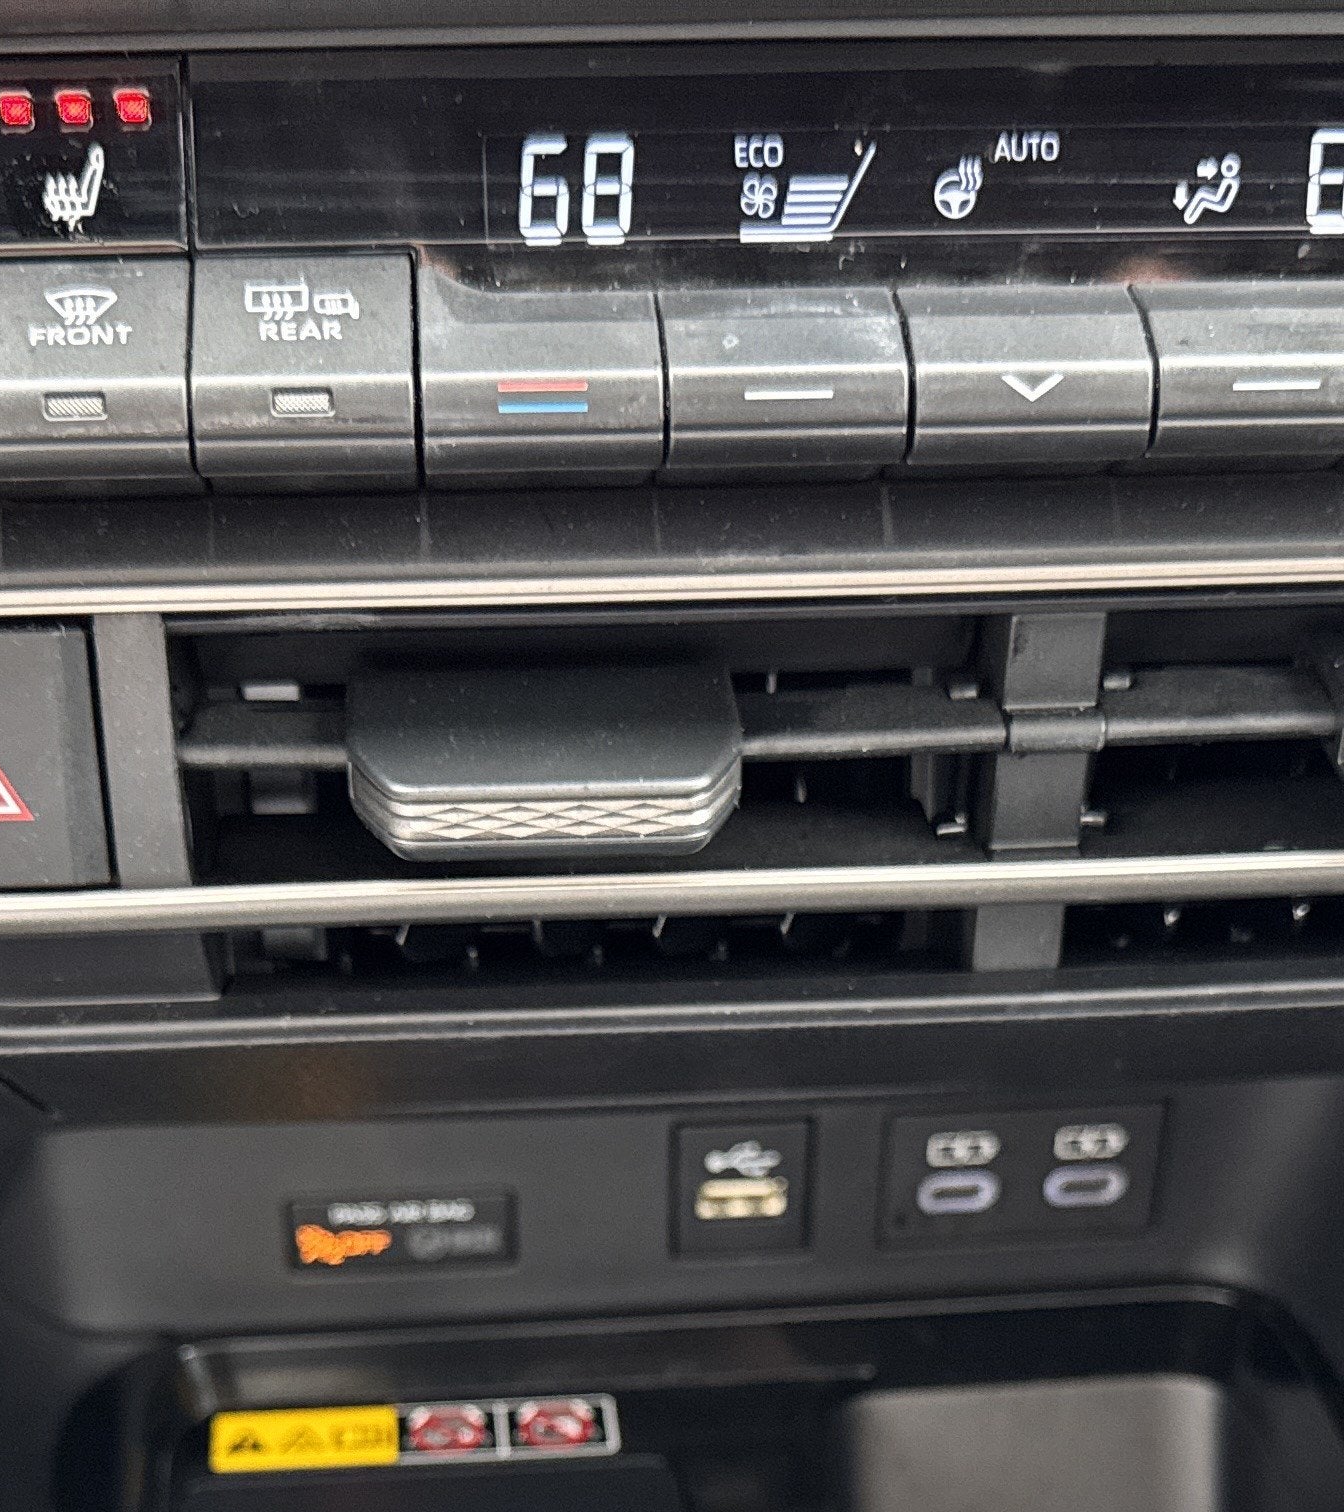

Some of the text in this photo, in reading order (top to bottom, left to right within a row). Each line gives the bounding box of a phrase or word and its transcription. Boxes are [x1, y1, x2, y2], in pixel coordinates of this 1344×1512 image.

[733, 134, 785, 168] ECO
[994, 131, 1061, 163] AUTO
[517, 133, 635, 247] 68
[28, 322, 133, 348] FRONT
[258, 318, 344, 342] REAR
